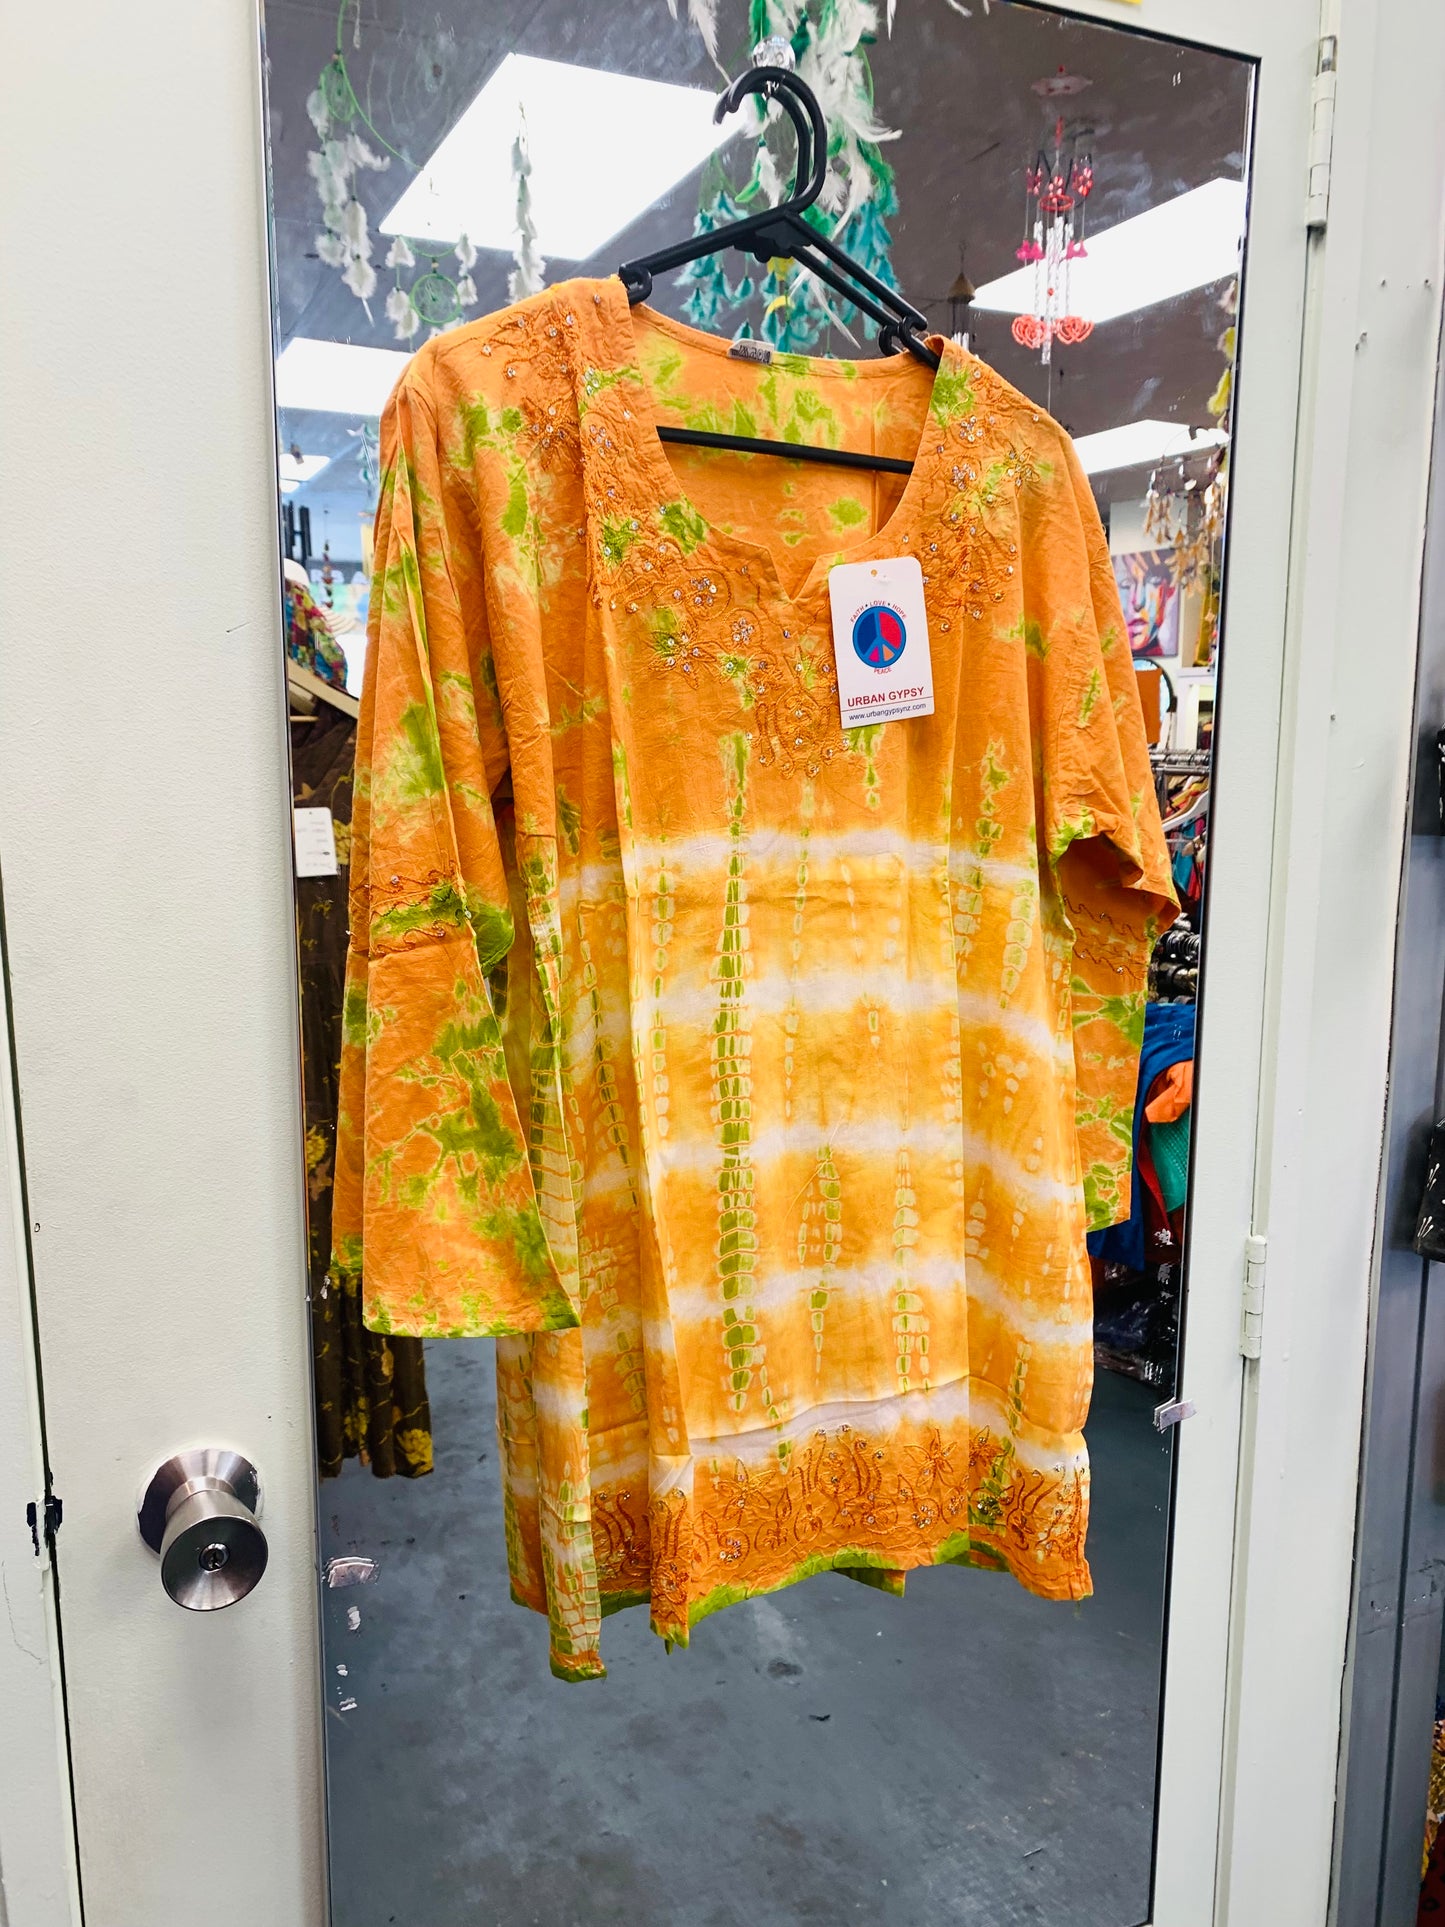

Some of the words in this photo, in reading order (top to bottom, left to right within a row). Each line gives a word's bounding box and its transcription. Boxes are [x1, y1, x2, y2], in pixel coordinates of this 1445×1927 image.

[850, 606, 865, 623] FAITH
[892, 604, 907, 619] HOPE
[874, 667, 892, 675] PEACE
[848, 693, 885, 707] URBAN
[888, 687, 924, 701] GYPSY
[849, 703, 926, 720] www.urbangypsynz.com
